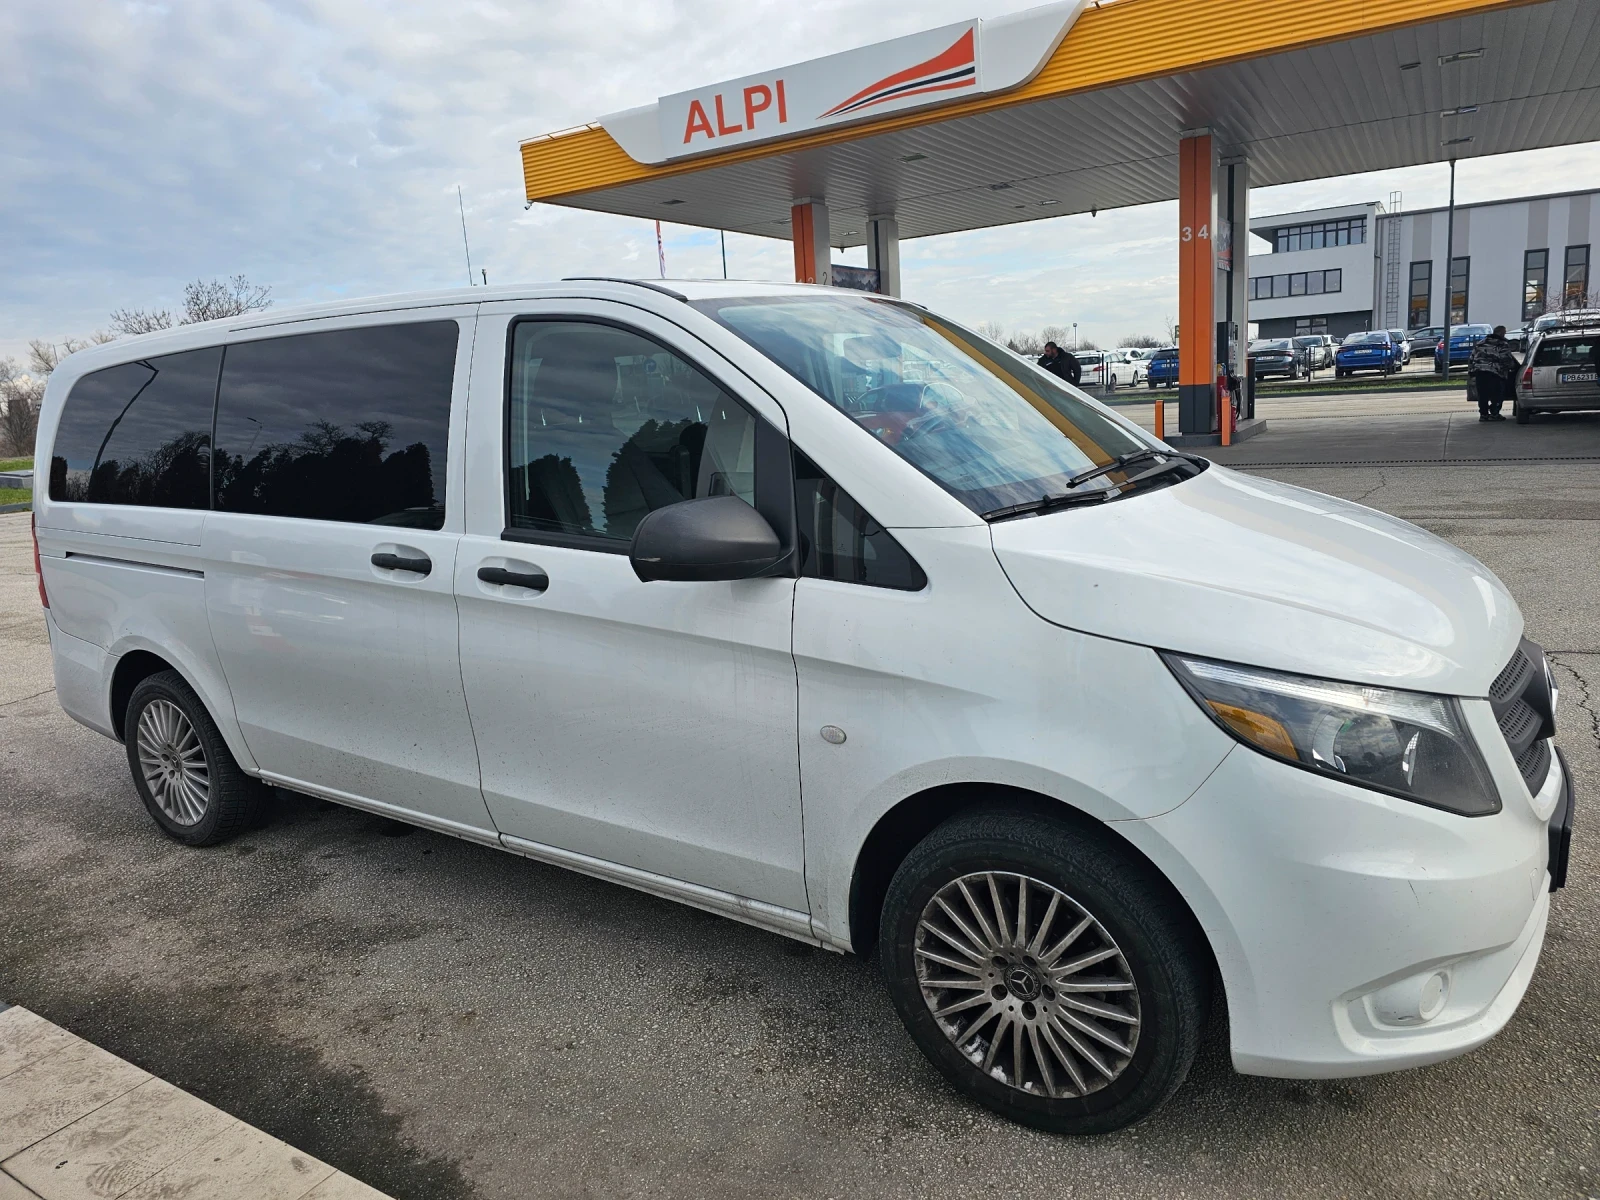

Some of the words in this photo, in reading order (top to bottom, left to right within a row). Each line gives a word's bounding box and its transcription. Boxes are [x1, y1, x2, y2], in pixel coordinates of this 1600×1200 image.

[683, 79, 787, 144] ALPI
[1181, 226, 1192, 242] 3
[1197, 224, 1209, 240] 4
